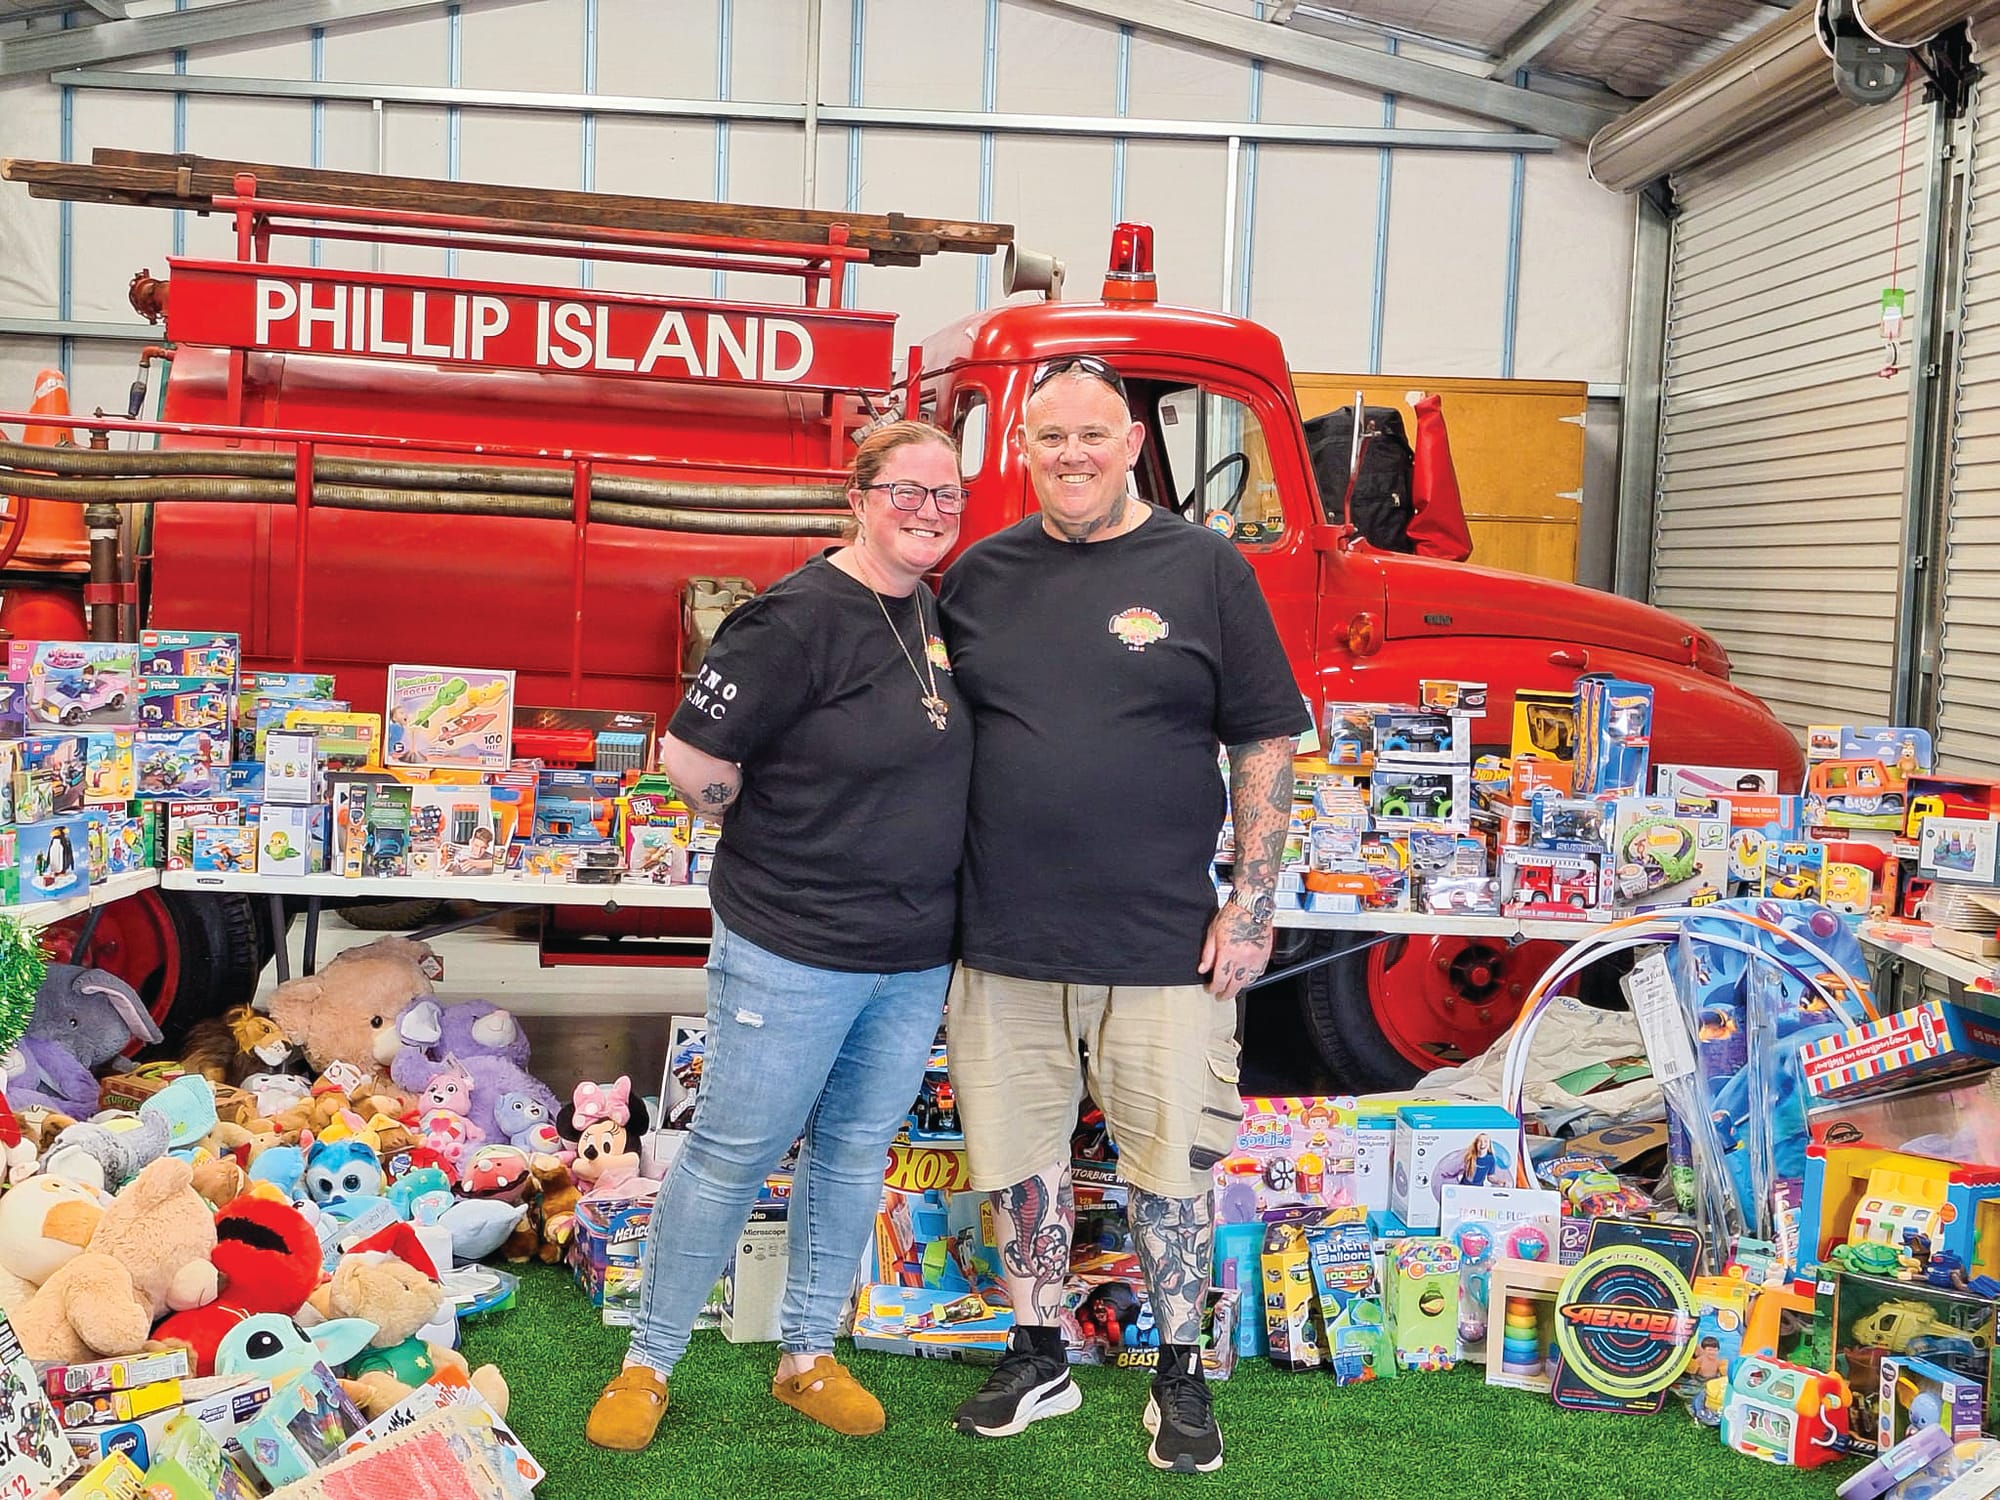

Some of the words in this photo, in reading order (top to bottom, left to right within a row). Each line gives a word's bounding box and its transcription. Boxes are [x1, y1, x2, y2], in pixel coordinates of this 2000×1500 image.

[255, 279, 511, 361] PHILLIP
[536, 301, 814, 383] ISLAND
[484, 734, 503, 745] 100
[743, 1228, 786, 1237] Microscope
[1316, 1241, 1362, 1255] Bunch
[1317, 1251, 1371, 1265] Balloons
[1570, 1307, 1697, 1336] AEROBIE
